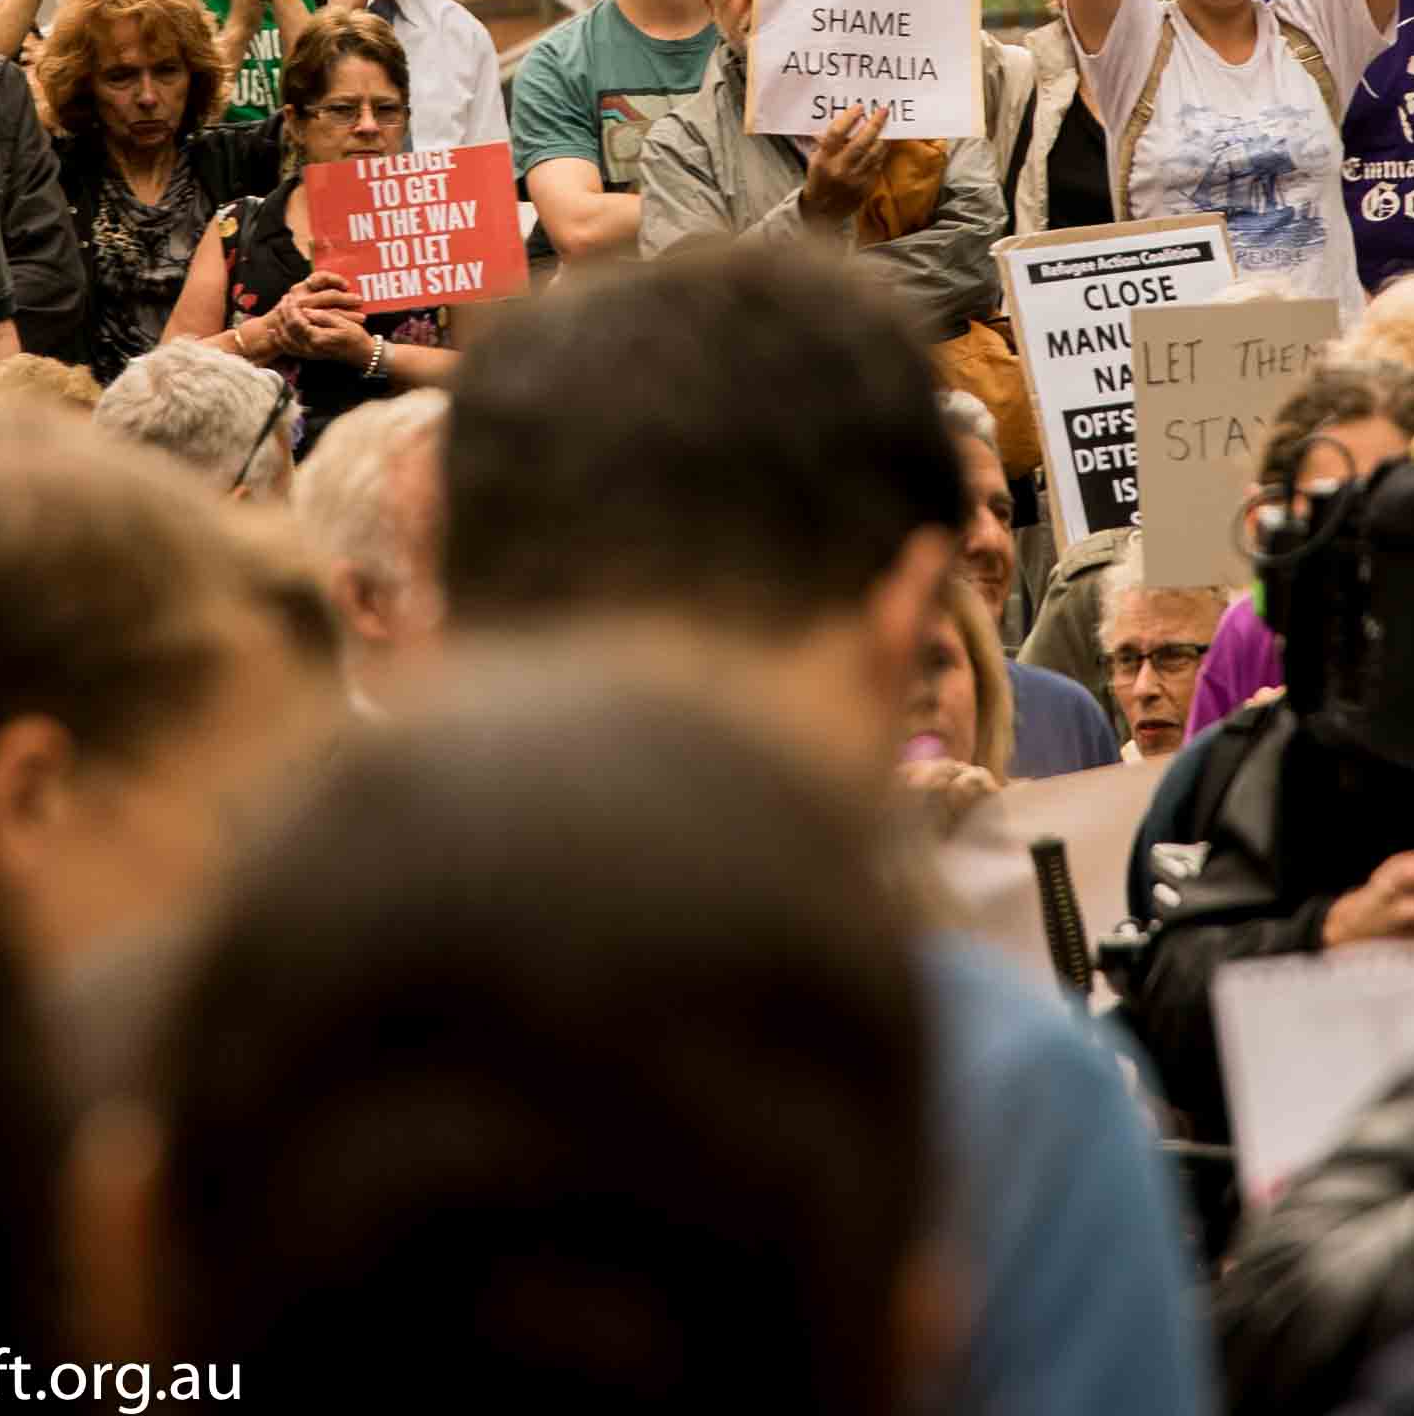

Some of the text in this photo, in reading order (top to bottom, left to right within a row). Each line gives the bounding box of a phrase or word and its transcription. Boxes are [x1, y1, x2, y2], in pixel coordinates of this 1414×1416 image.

[810, 7, 912, 38] SHAME
[781, 50, 939, 82] AUSTRALIA
[368, 173, 448, 209] TO GET
[348, 199, 478, 242] IN THE WAY
[376, 233, 451, 270] TO LET
[1235, 247, 1309, 267] PEOPLE
[356, 260, 484, 303] THEM STAY
[1083, 275, 1179, 311] CLOSE
[1143, 338, 1203, 385] LET
[1164, 415, 1268, 461] STA
